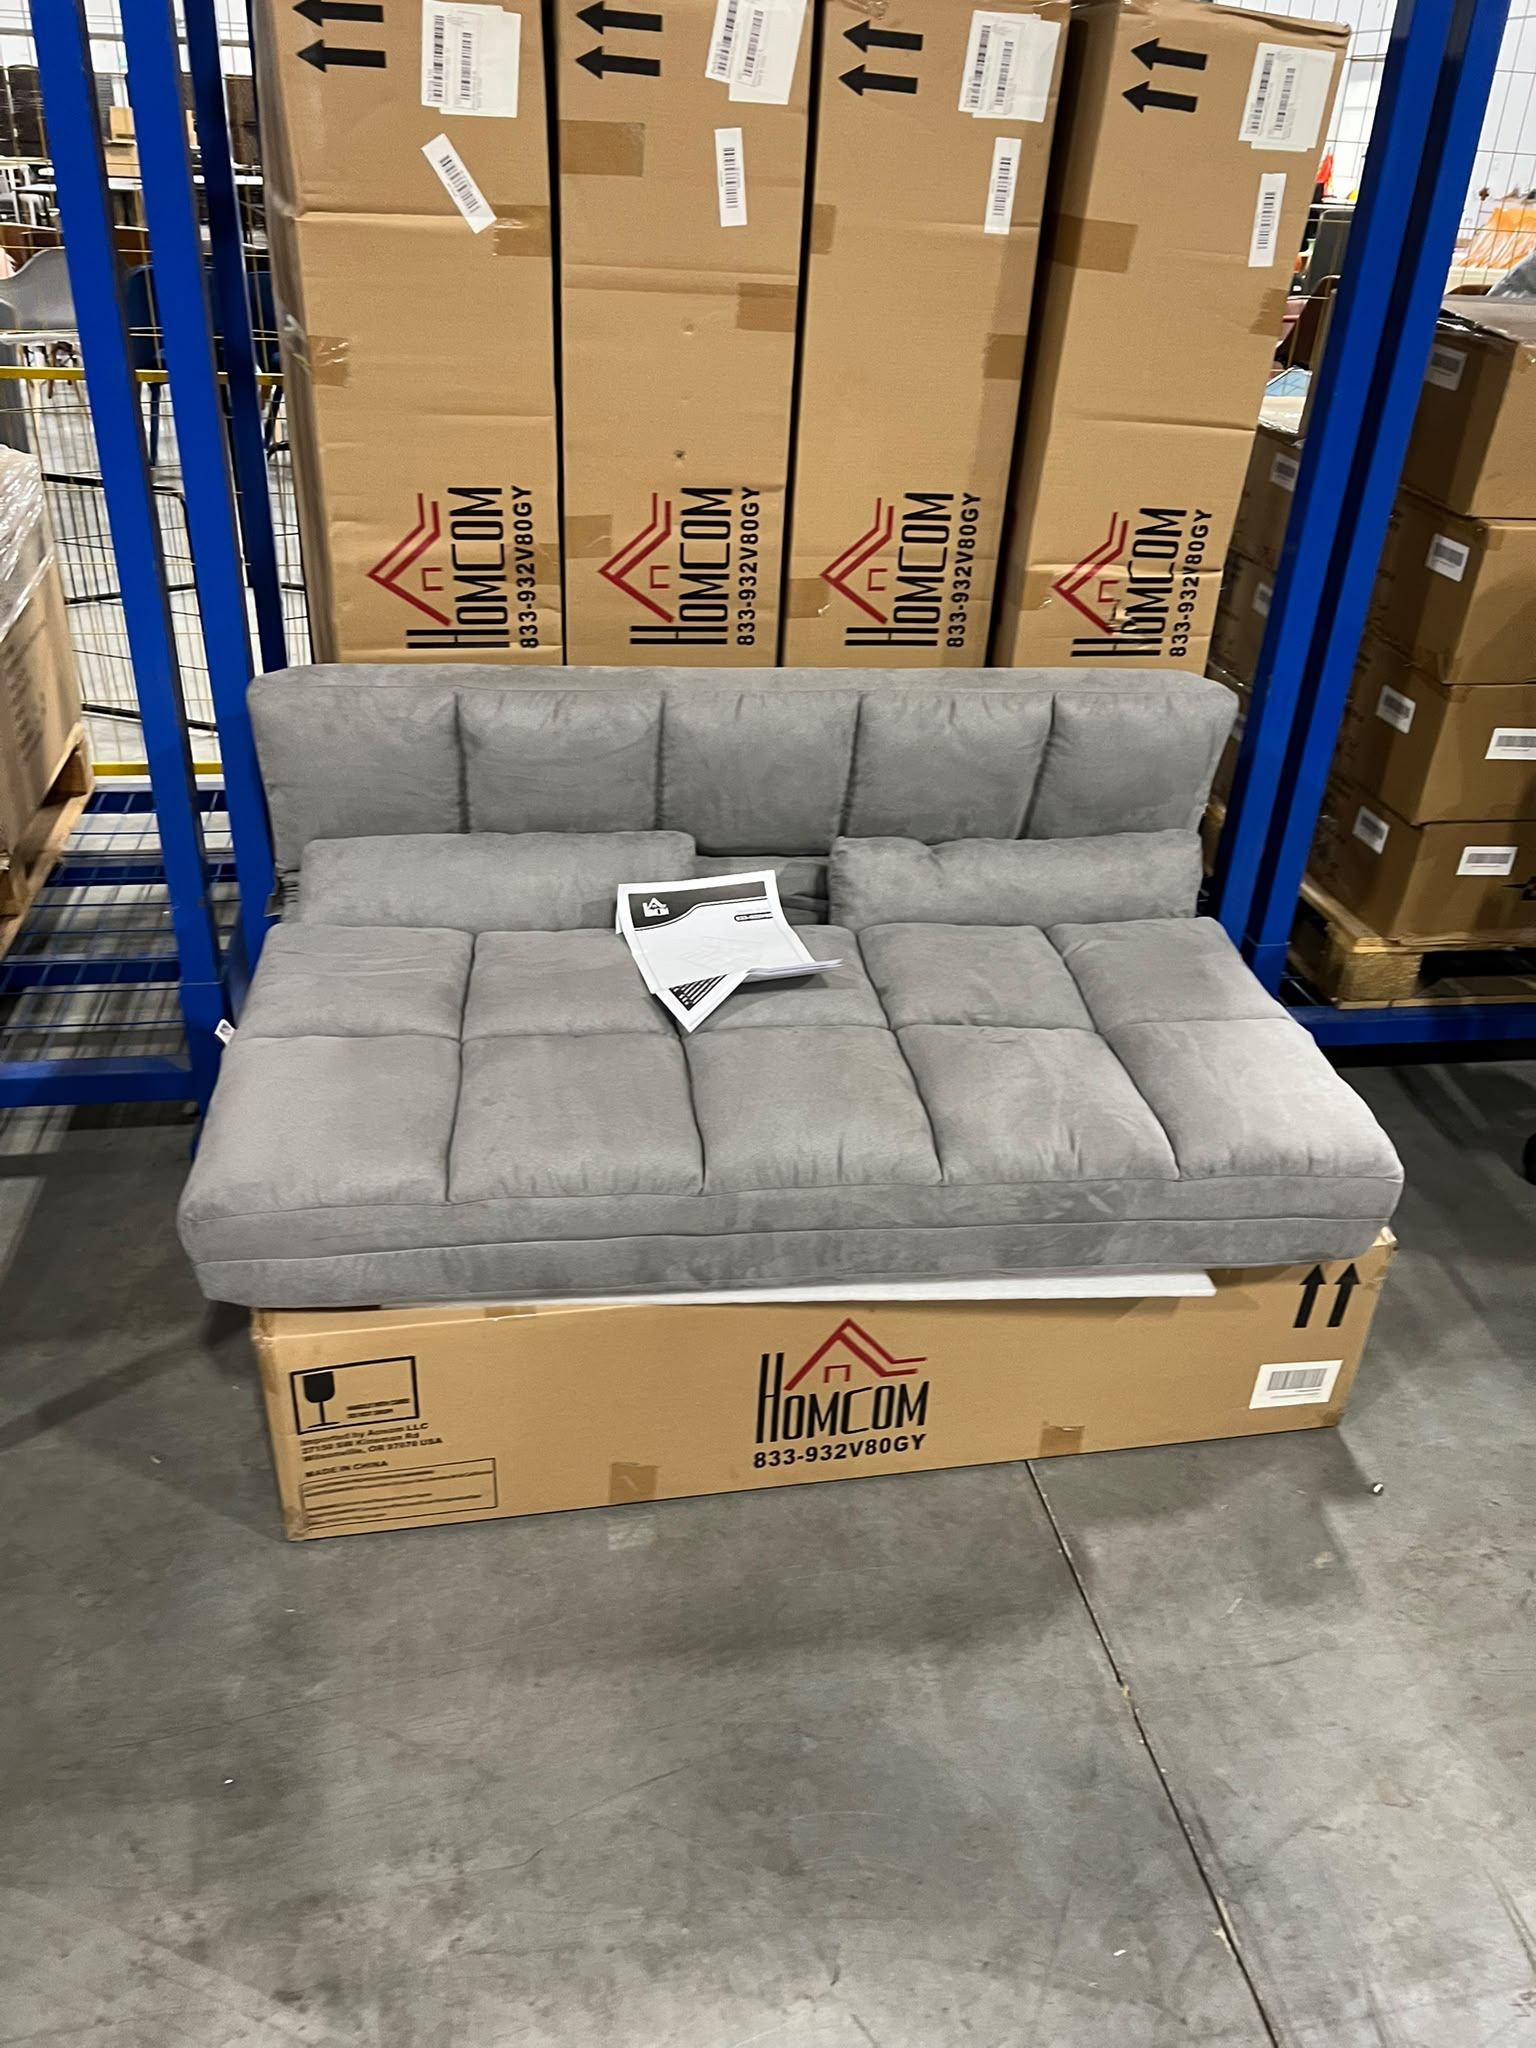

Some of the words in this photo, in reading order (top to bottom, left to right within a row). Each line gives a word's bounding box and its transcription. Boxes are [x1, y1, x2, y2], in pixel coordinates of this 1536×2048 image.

[512, 486, 539, 648] 833-932V80GY
[735, 486, 762, 646] 833-932V80GY
[946, 492, 982, 648] 833-932V80GY
[1170, 509, 1212, 657] 833-932V80GY
[305, 1466, 337, 1477] MADE
[340, 1464, 351, 1472] IN
[353, 1461, 388, 1471] CHINA
[368, 1445, 385, 1453] OR
[406, 1422, 429, 1432] LLC
[753, 1433, 927, 1468] 833-932V80GY
